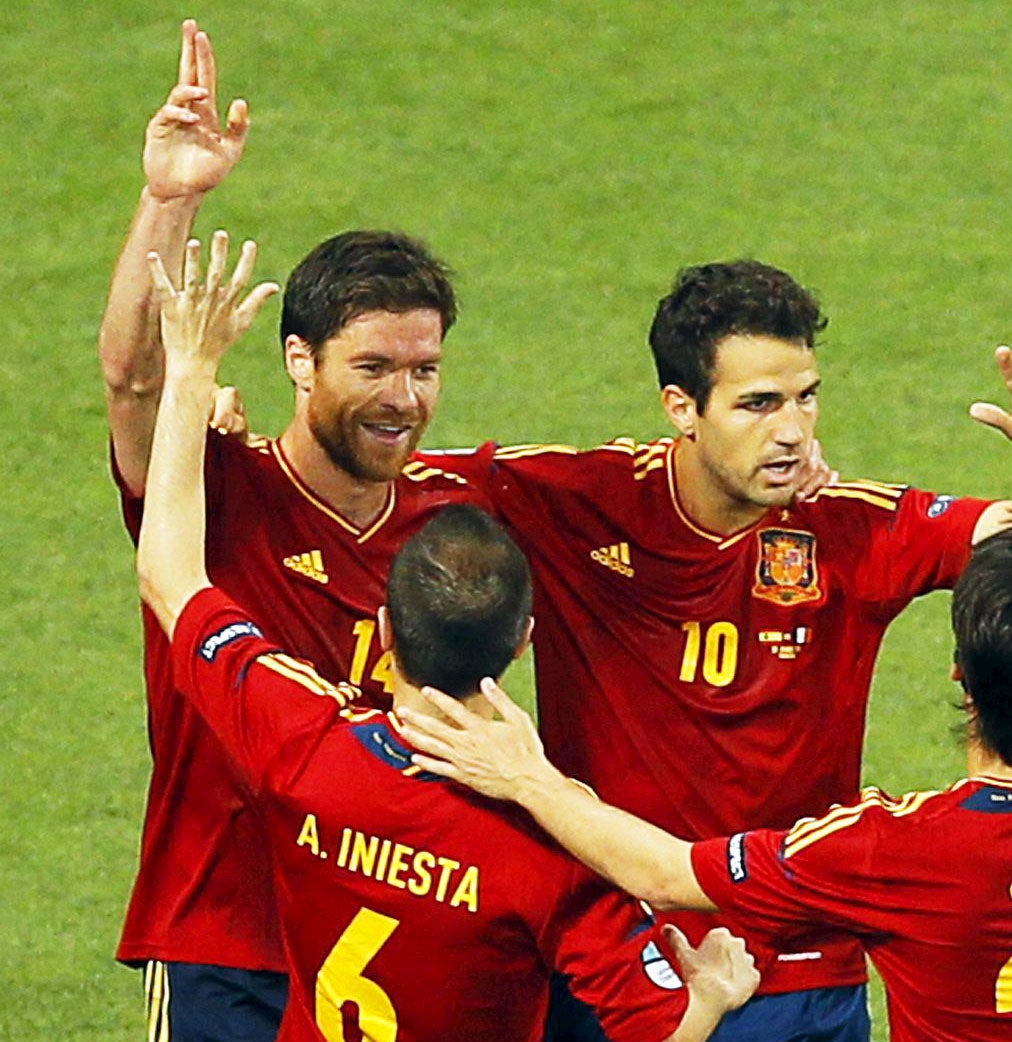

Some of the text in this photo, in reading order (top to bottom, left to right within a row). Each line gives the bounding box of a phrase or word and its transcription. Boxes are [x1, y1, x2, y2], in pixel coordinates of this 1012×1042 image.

[349, 619, 397, 694] 14
[679, 621, 739, 687] 10
[296, 813, 479, 913] A. INIESTA
